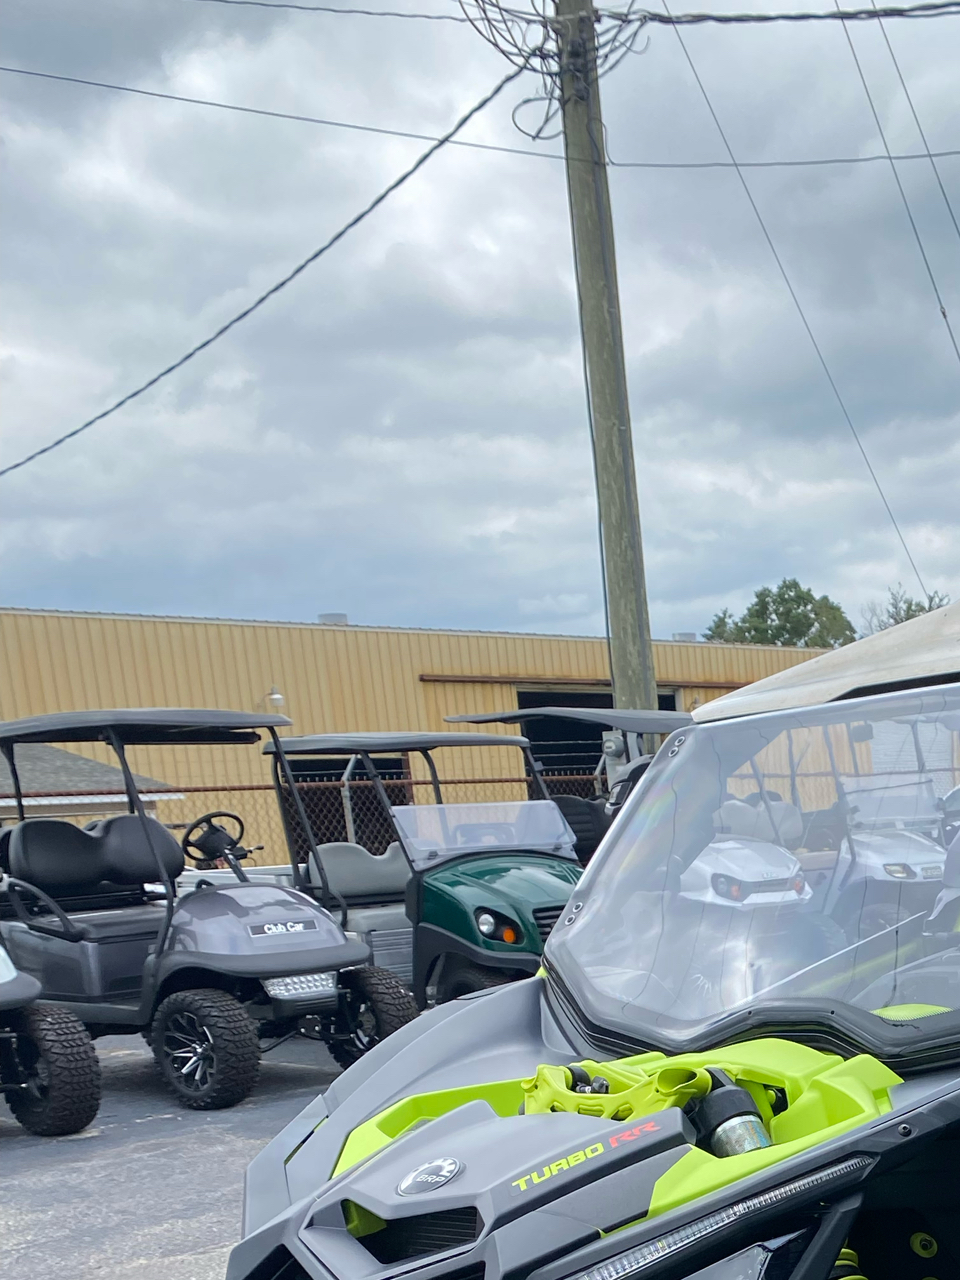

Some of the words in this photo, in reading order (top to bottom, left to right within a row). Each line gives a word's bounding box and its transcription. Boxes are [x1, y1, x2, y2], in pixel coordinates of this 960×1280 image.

[263, 923, 286, 934] Club
[286, 921, 305, 932] Car
[511, 1142, 605, 1191] TURBO
[608, 1121, 662, 1148] RR
[415, 1174, 446, 1183] BRP
